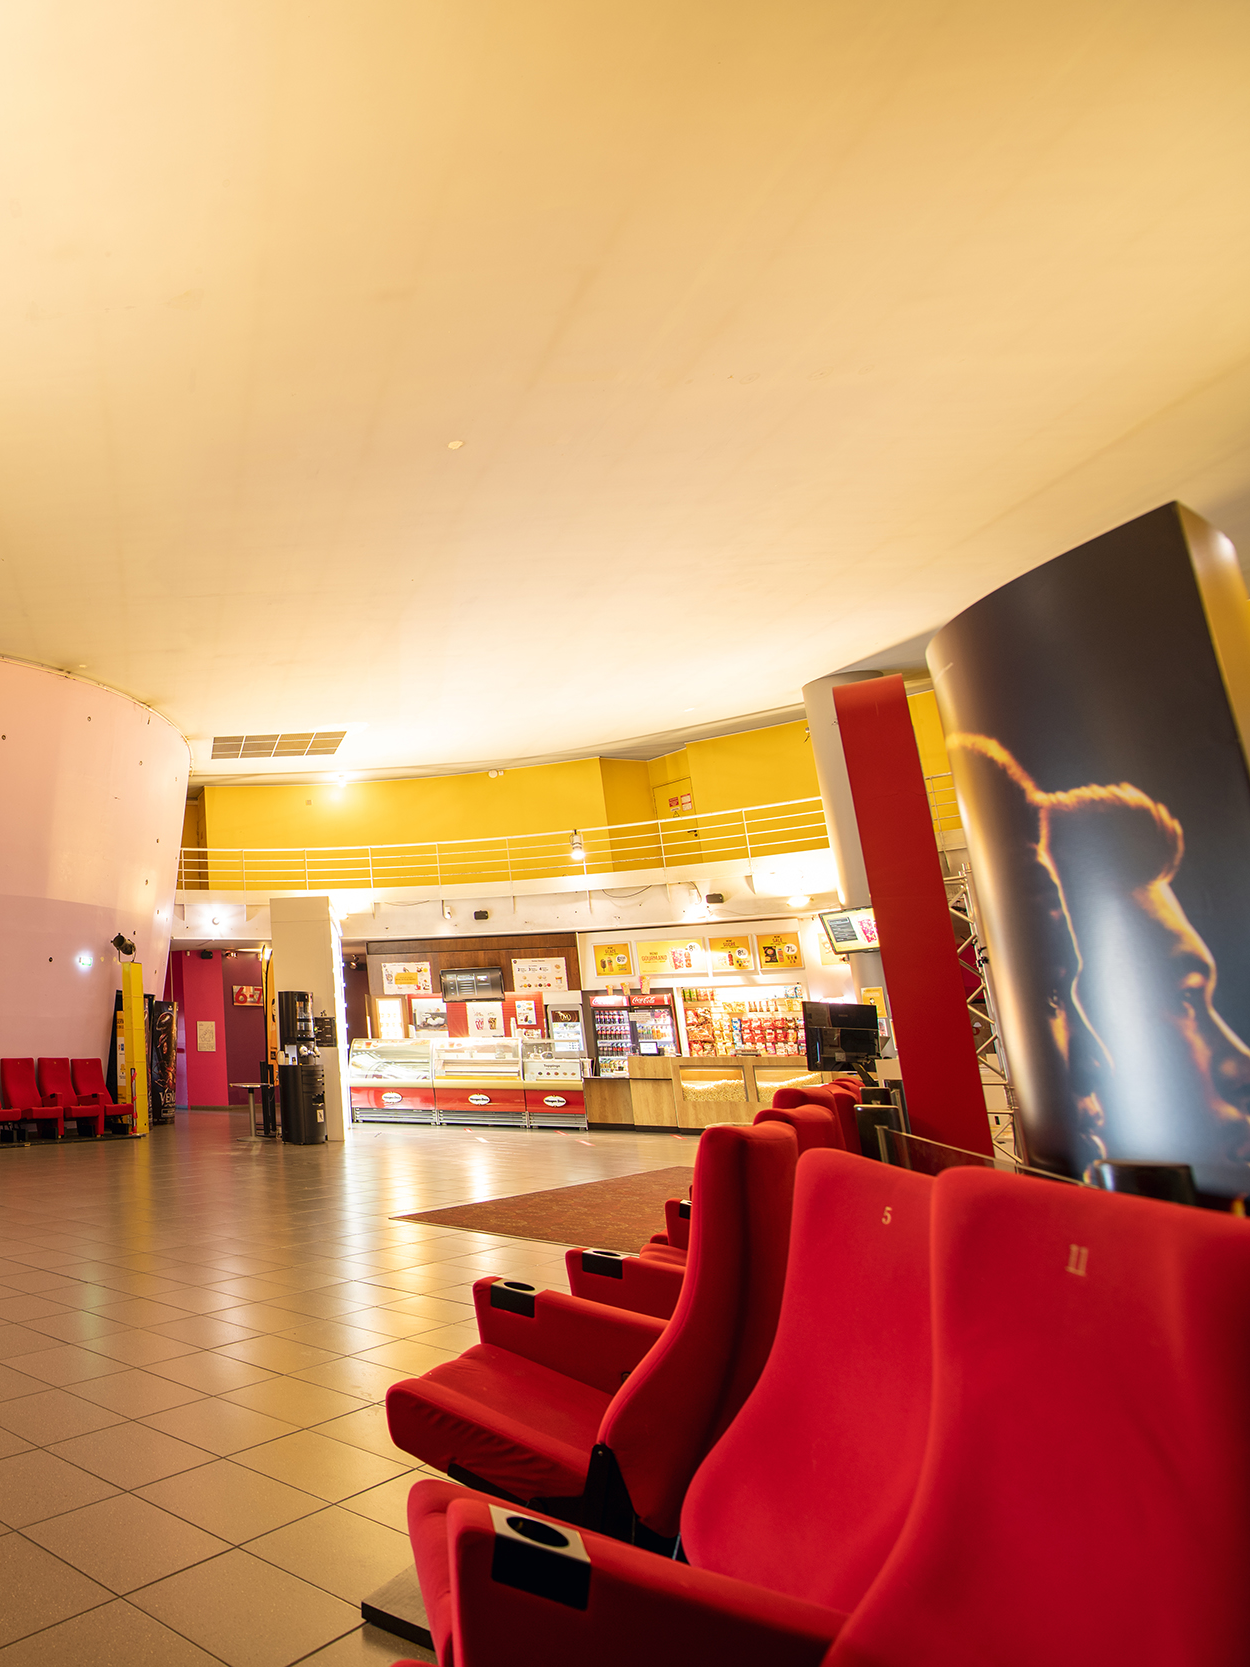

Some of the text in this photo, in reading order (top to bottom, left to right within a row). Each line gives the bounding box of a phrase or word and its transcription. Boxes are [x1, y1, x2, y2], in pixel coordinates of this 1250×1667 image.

[234, 986, 263, 1005] 6-7
[881, 1206, 893, 1225] 5
[1065, 1244, 1089, 1277] 11
